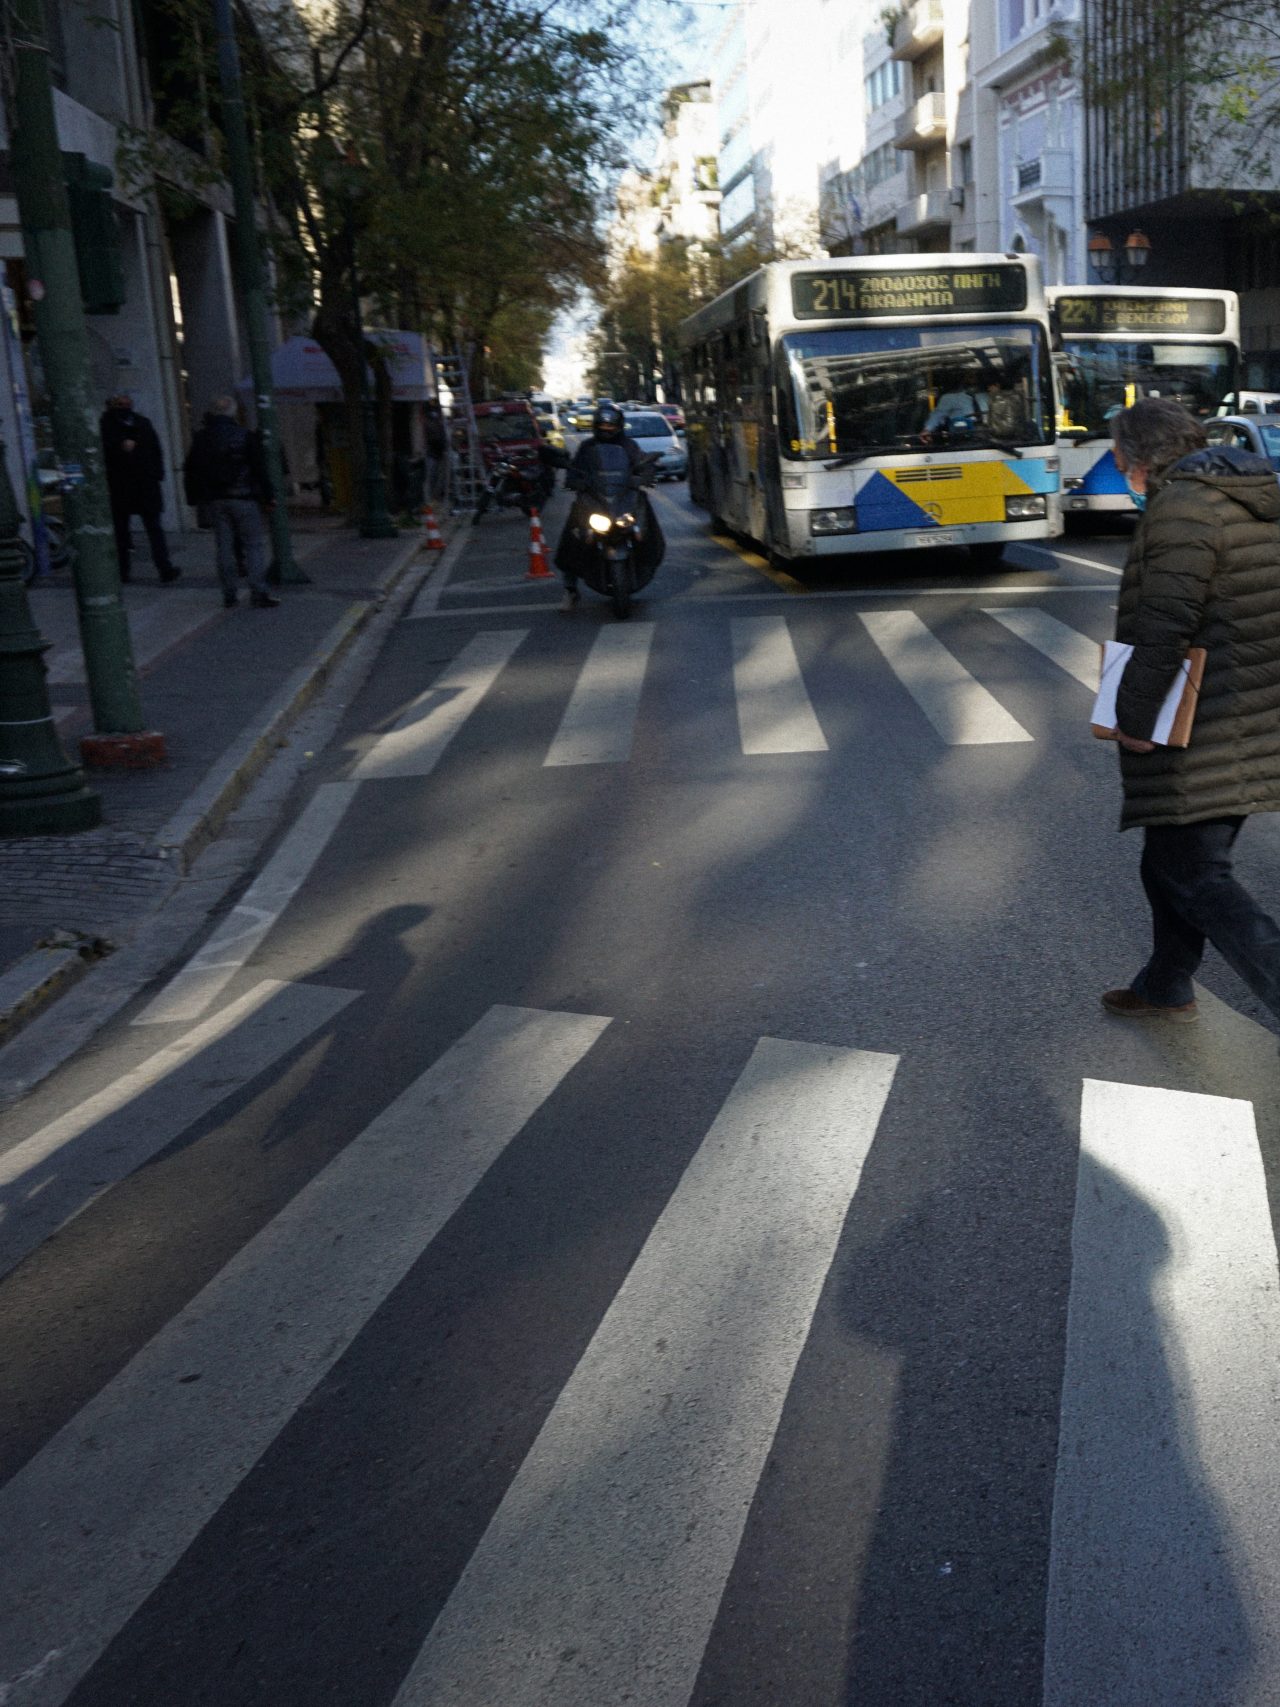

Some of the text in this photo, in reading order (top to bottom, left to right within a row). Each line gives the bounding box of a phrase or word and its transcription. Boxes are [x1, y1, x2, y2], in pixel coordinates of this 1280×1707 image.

[812, 278, 857, 311] 214
[953, 272, 1002, 289] ΠΗΓΗ
[859, 291, 954, 309] ΑΚΑΔΗΜΙΑ
